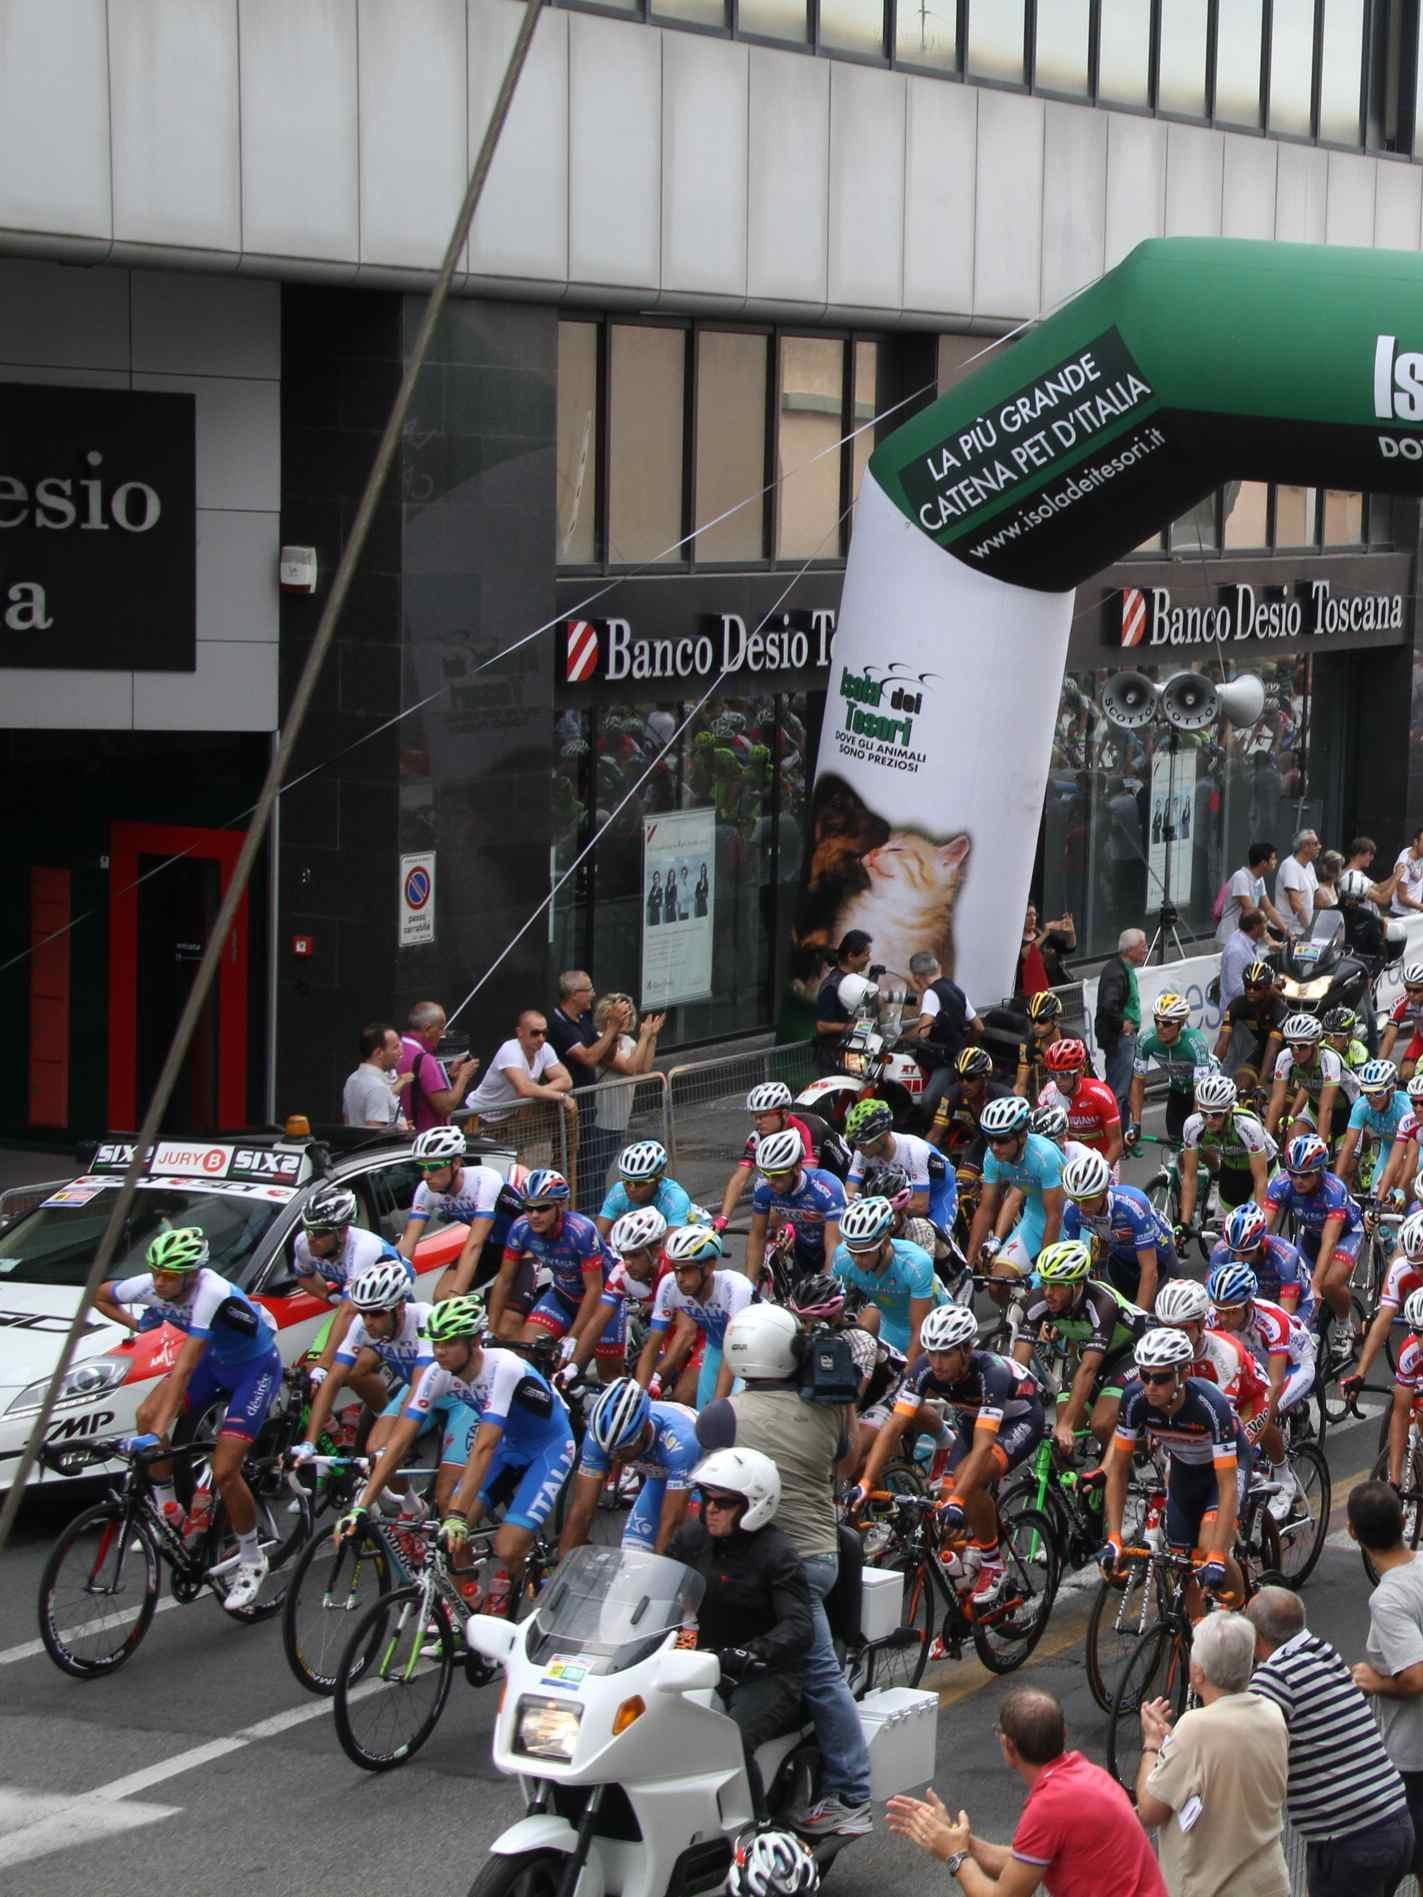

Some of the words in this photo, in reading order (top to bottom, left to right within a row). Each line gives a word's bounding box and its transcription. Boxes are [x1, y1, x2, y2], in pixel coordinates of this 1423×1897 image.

[927, 448, 961, 481] LA
[959, 417, 997, 461] PIÙ
[1000, 353, 1101, 433] GRANDE
[919, 460, 1018, 531] CATENA
[1011, 431, 1055, 474] PET
[1051, 374, 1151, 448] D'ITALIA
[970, 427, 1166, 558] www.isoladeitesori.it
[1150, 587, 1231, 645] Banco
[1234, 583, 1302, 640] Desio
[1312, 579, 1403, 634] Toscana
[605, 617, 713, 680] Banco
[720, 613, 809, 673] Desio
[840, 666, 881, 708] Isola
[890, 687, 923, 715] dei
[835, 730, 856, 745] DOVE
[858, 739, 874, 751] GLI
[876, 744, 927, 763] ANIMALI
[845, 700, 913, 747] Tesori
[839, 744, 865, 759] SONO
[868, 753, 919, 773] PREZIOSI
[158, 1151, 204, 1166] JURY
[234, 1151, 300, 1174] SIX2
